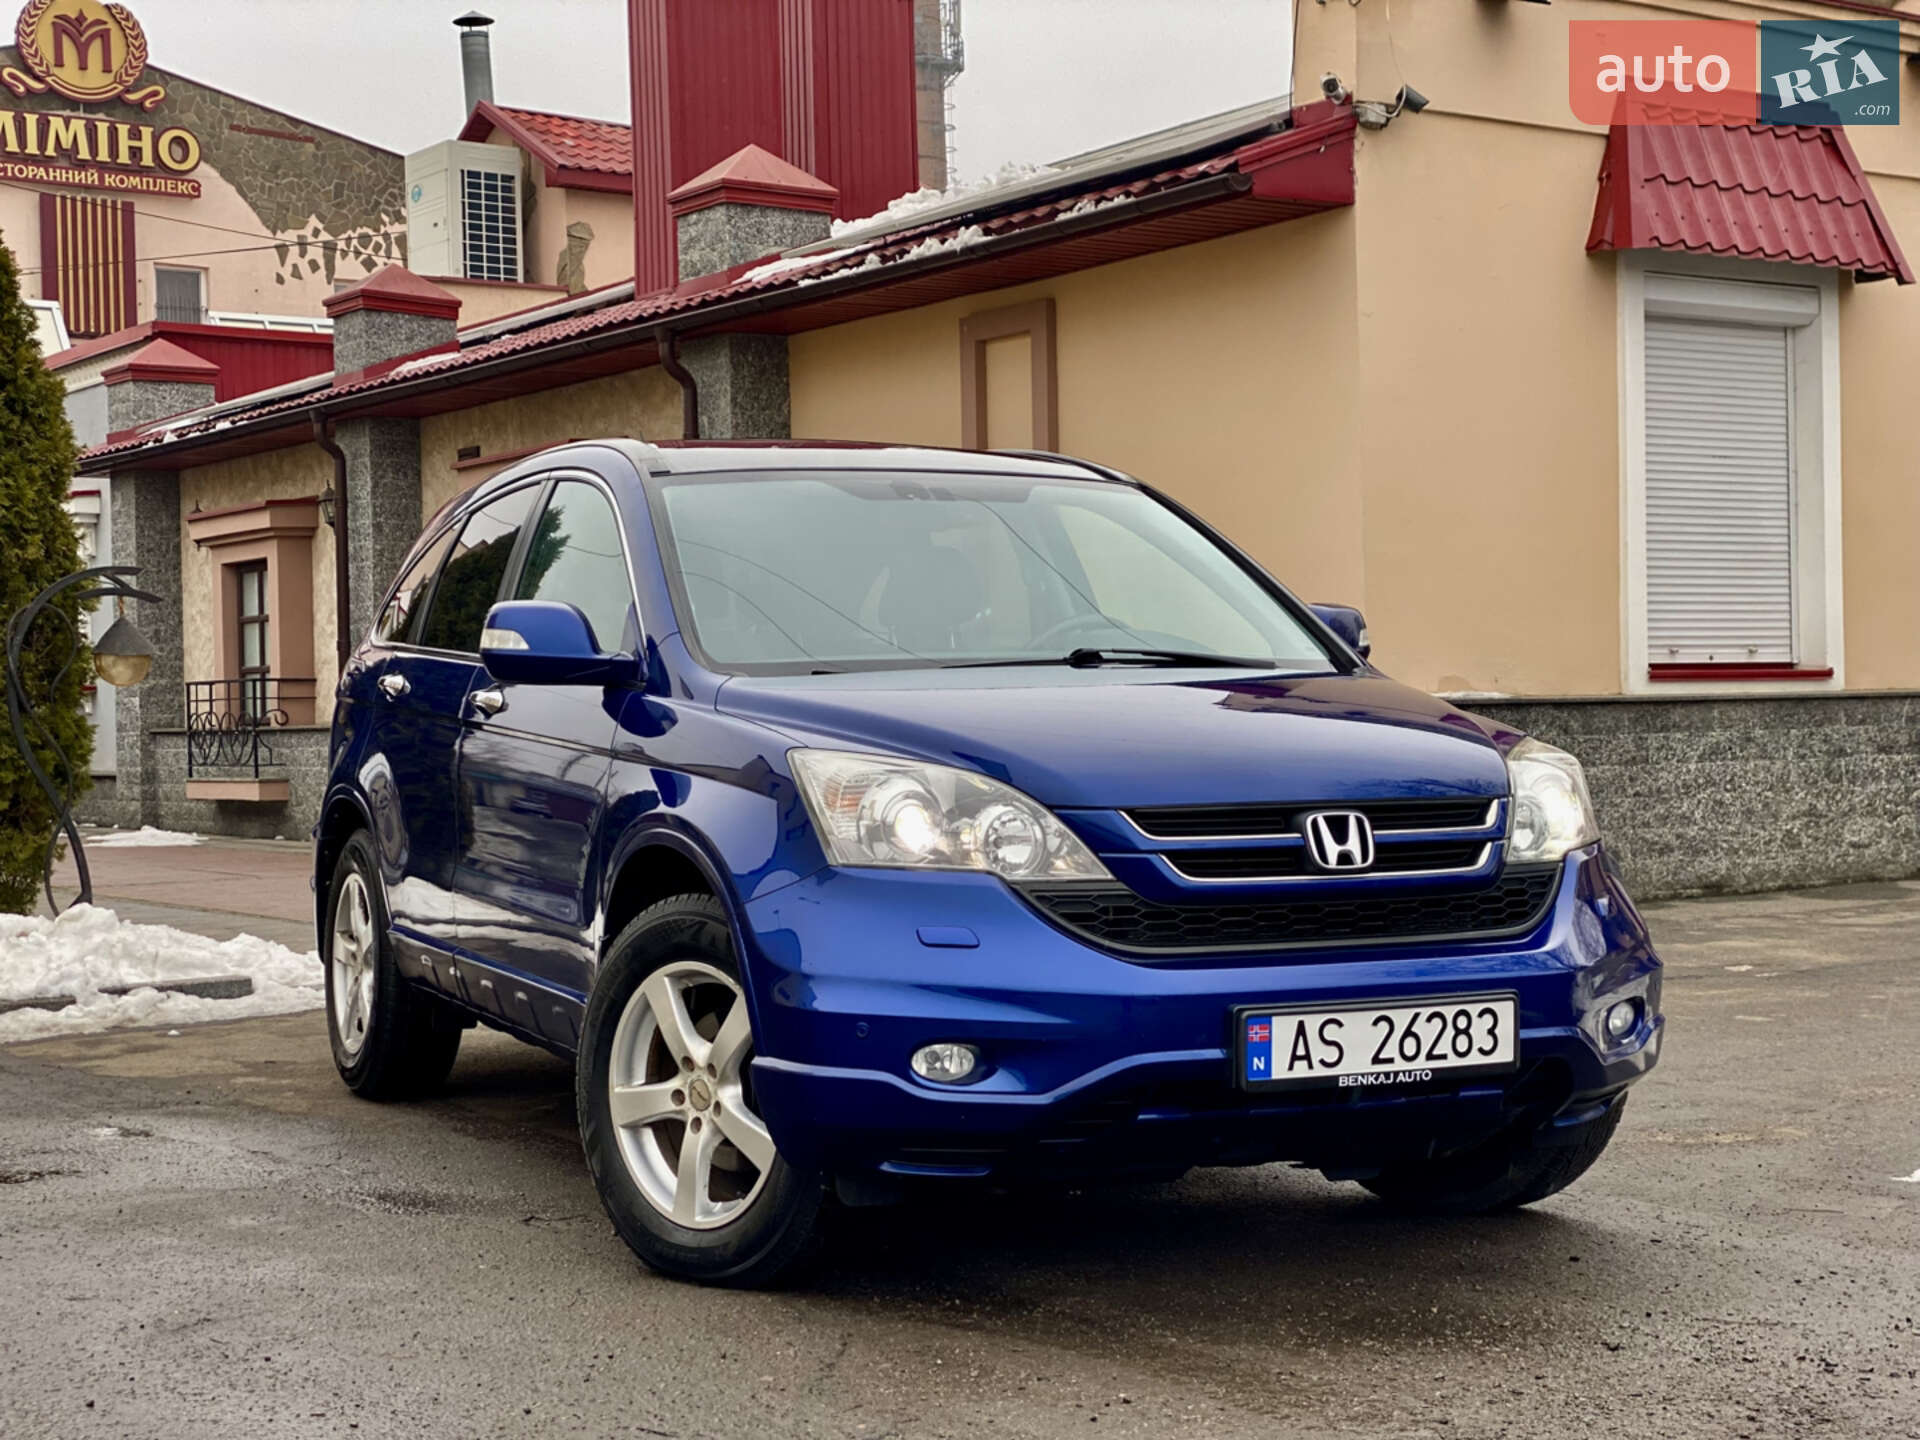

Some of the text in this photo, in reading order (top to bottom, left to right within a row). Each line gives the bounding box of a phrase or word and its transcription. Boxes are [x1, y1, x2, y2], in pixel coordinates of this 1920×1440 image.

[104, 173, 199, 195] КОМПЛЕКС
[1287, 1007, 1499, 1072] AS 26283
[1253, 1056, 1265, 1071] N
[1338, 1069, 1432, 1087] BENKAJ AUTO
